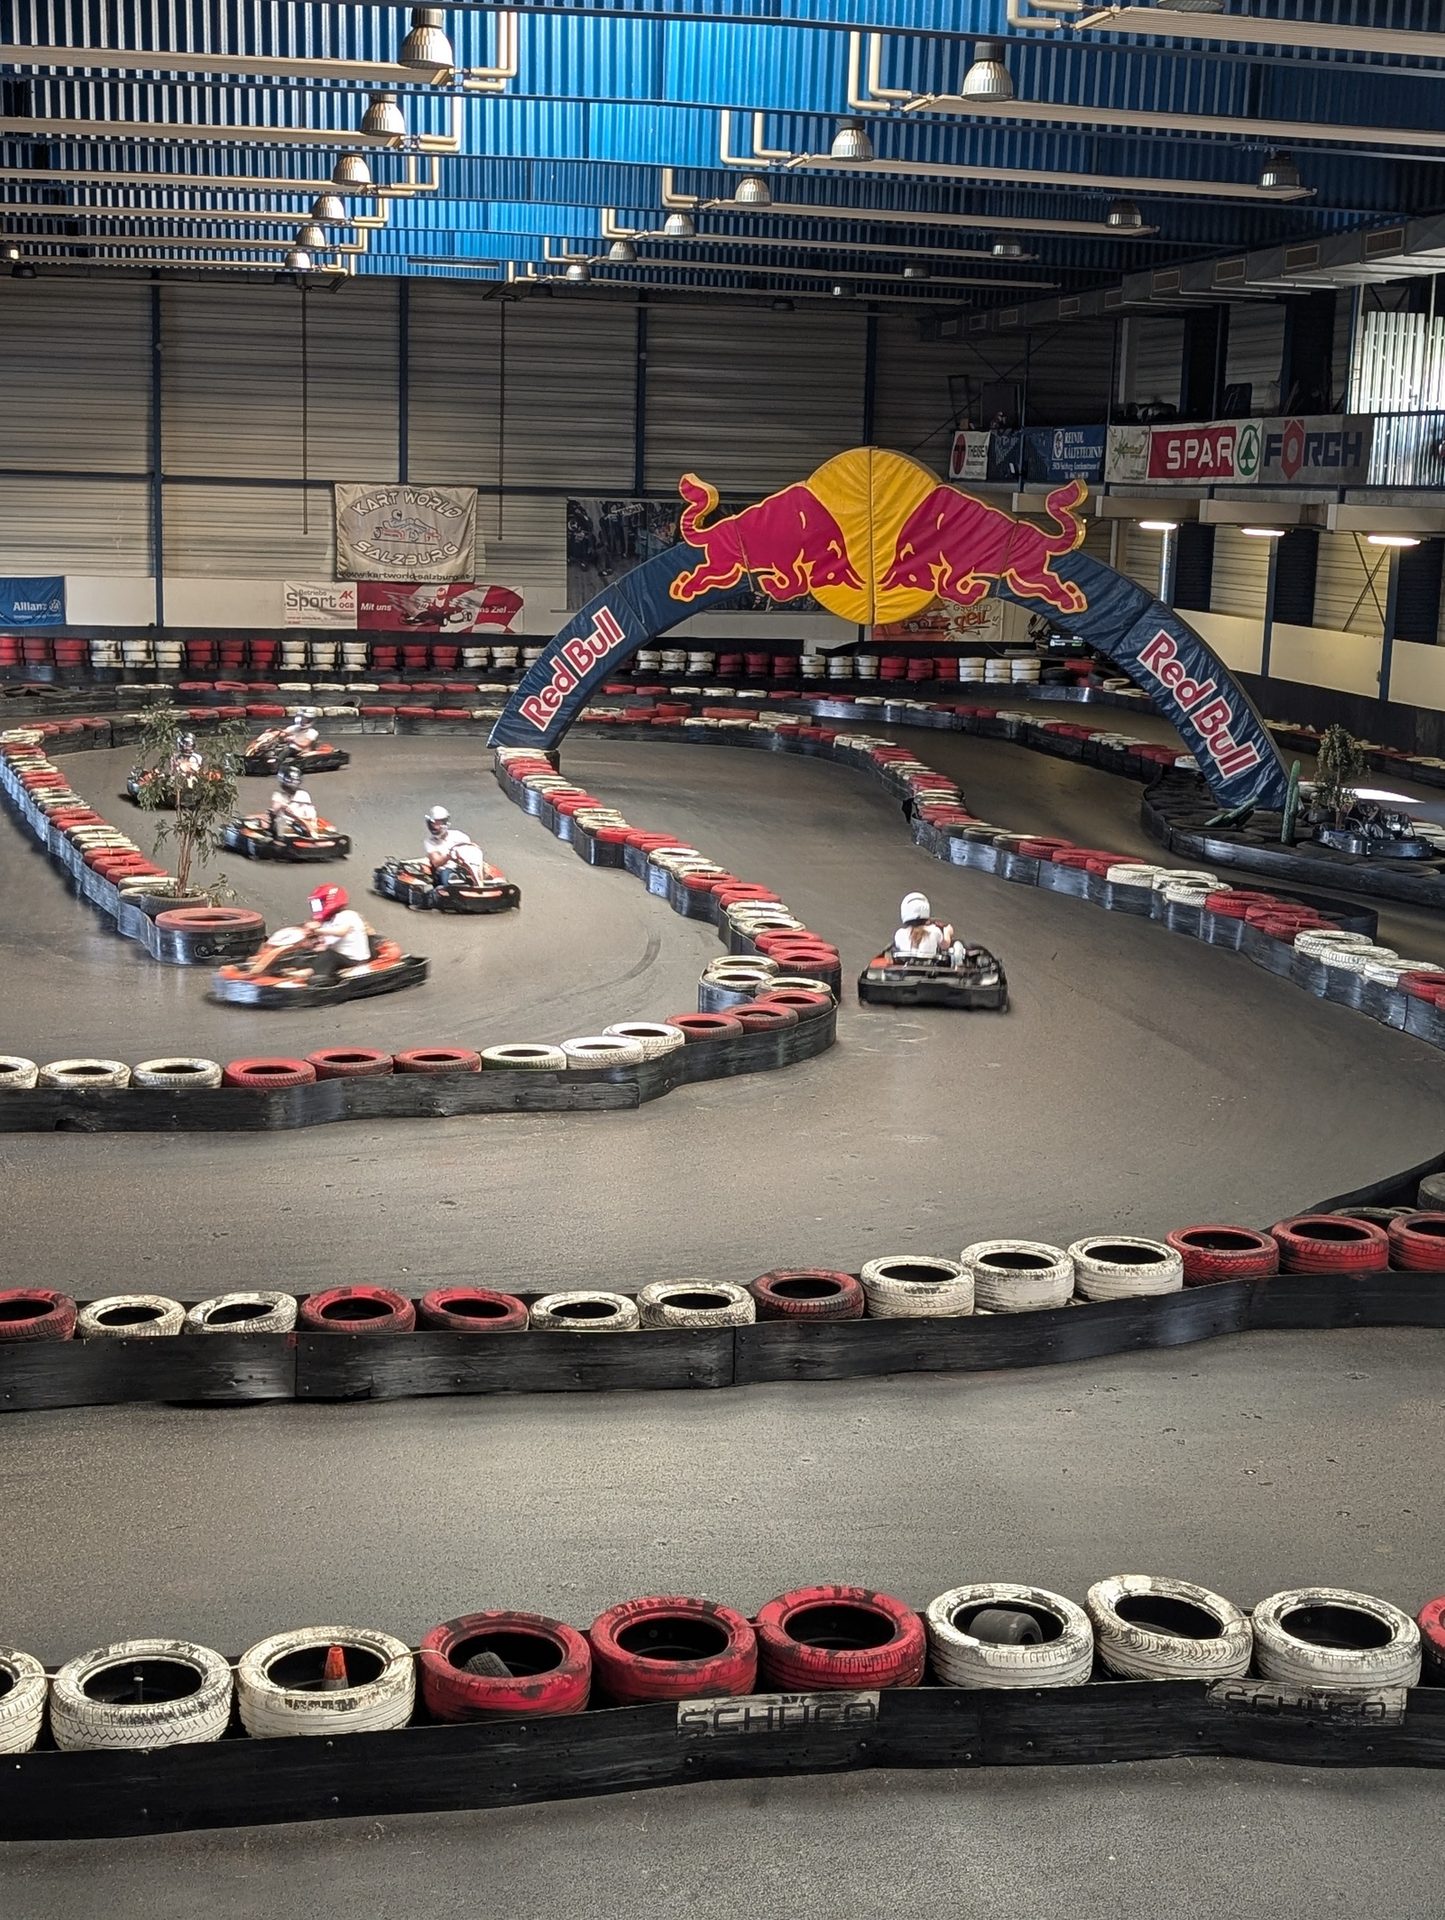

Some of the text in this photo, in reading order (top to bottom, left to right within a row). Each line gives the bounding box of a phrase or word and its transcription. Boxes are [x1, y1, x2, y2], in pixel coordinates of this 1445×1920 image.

[1166, 436, 1234, 470] SPAR
[351, 491, 464, 518] KART WORLD
[350, 540, 460, 565] SALZBURG
[286, 592, 337, 611] Sport
[340, 591, 354, 600] AK
[361, 603, 375, 611] Mit
[490, 605, 507, 614] Ziel
[518, 605, 626, 732] Red Bull
[1136, 628, 1262, 780] Red Bull
